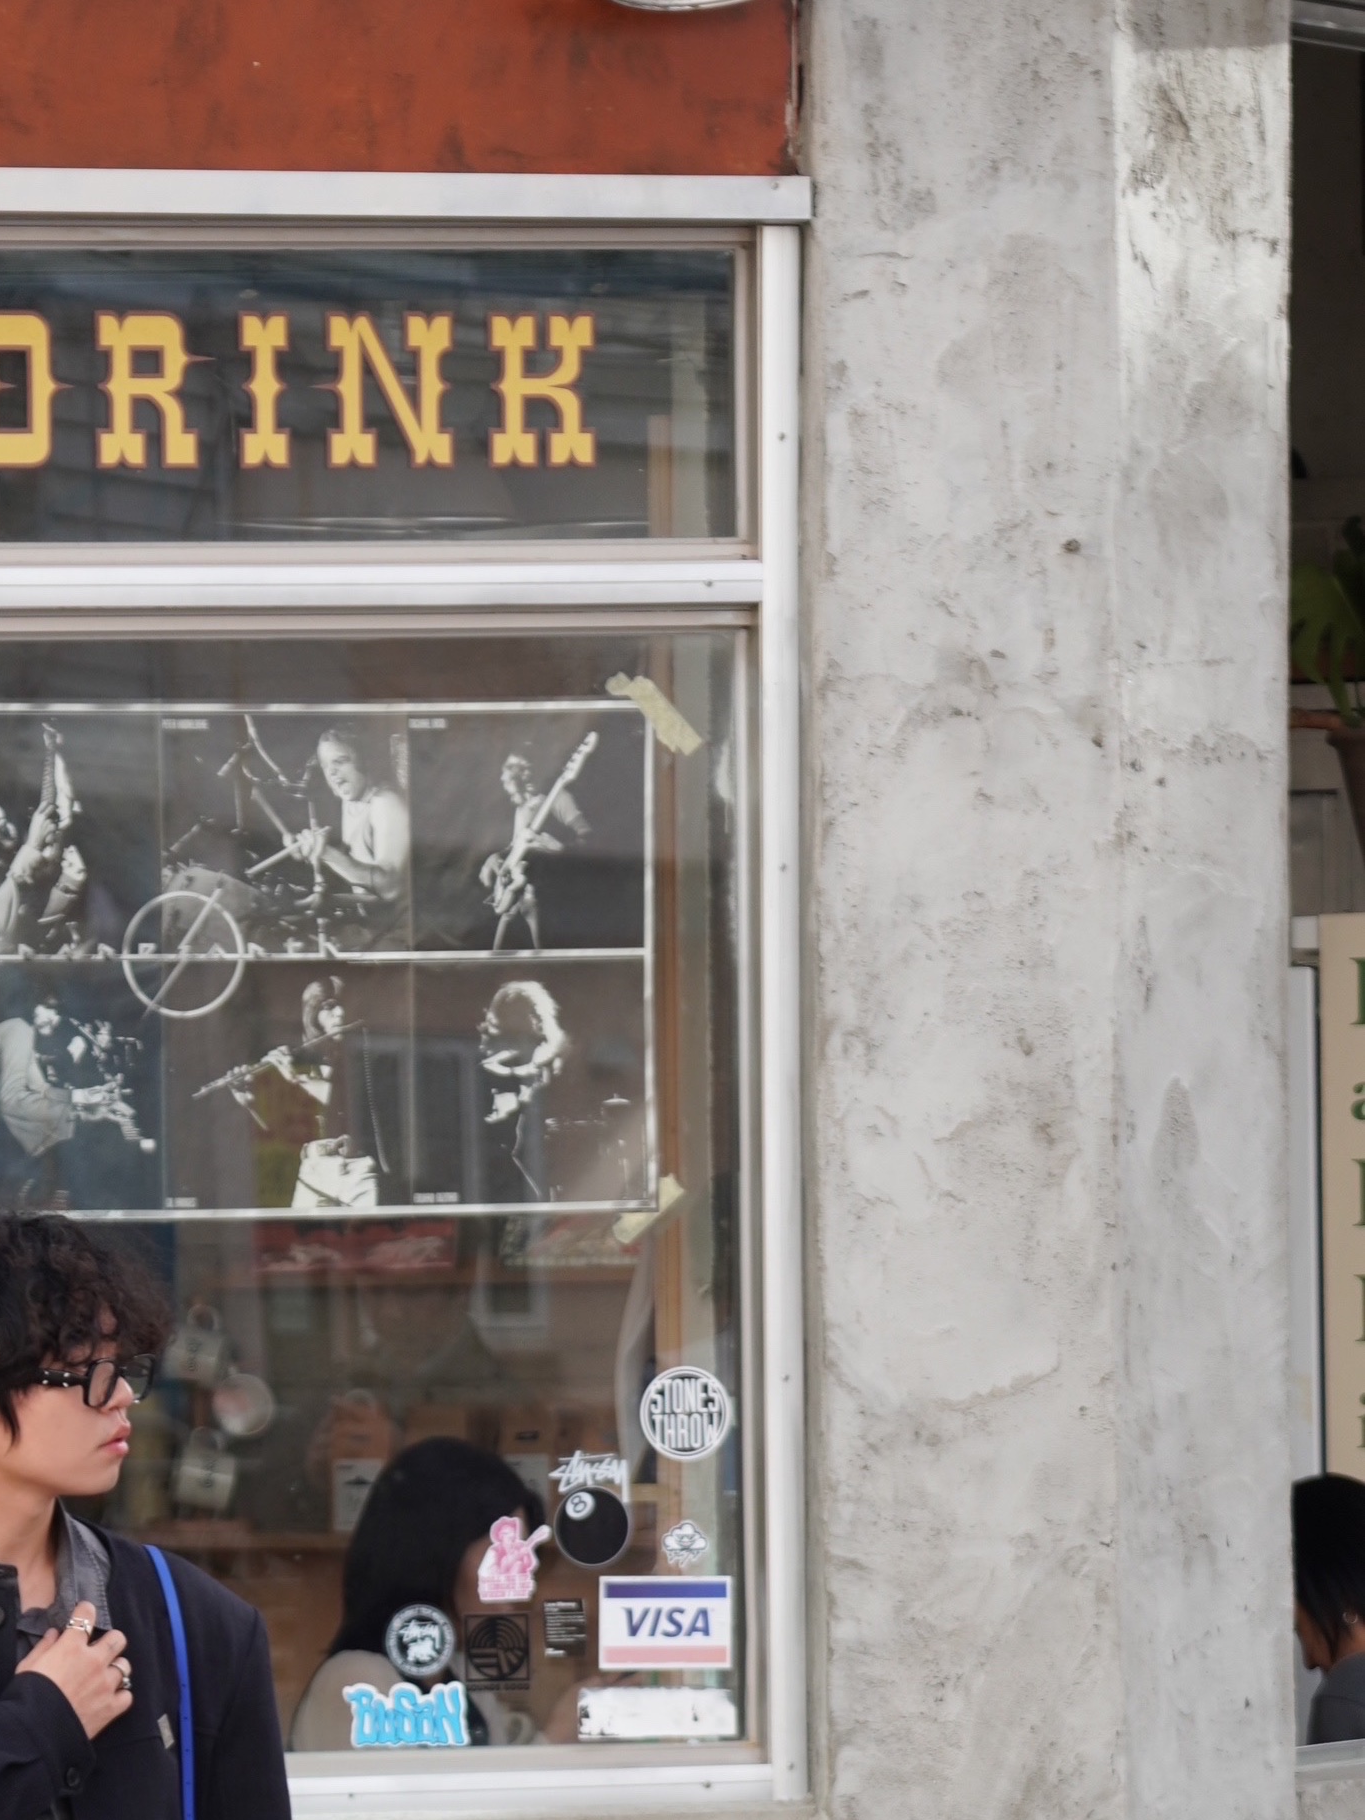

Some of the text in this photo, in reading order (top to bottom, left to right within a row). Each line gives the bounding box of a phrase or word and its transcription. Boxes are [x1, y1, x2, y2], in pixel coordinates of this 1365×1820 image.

[650, 1377, 720, 1413] STONES
[650, 1413, 720, 1450] THROW
[570, 1494, 588, 1514] 8
[624, 1606, 713, 1638] VISA
